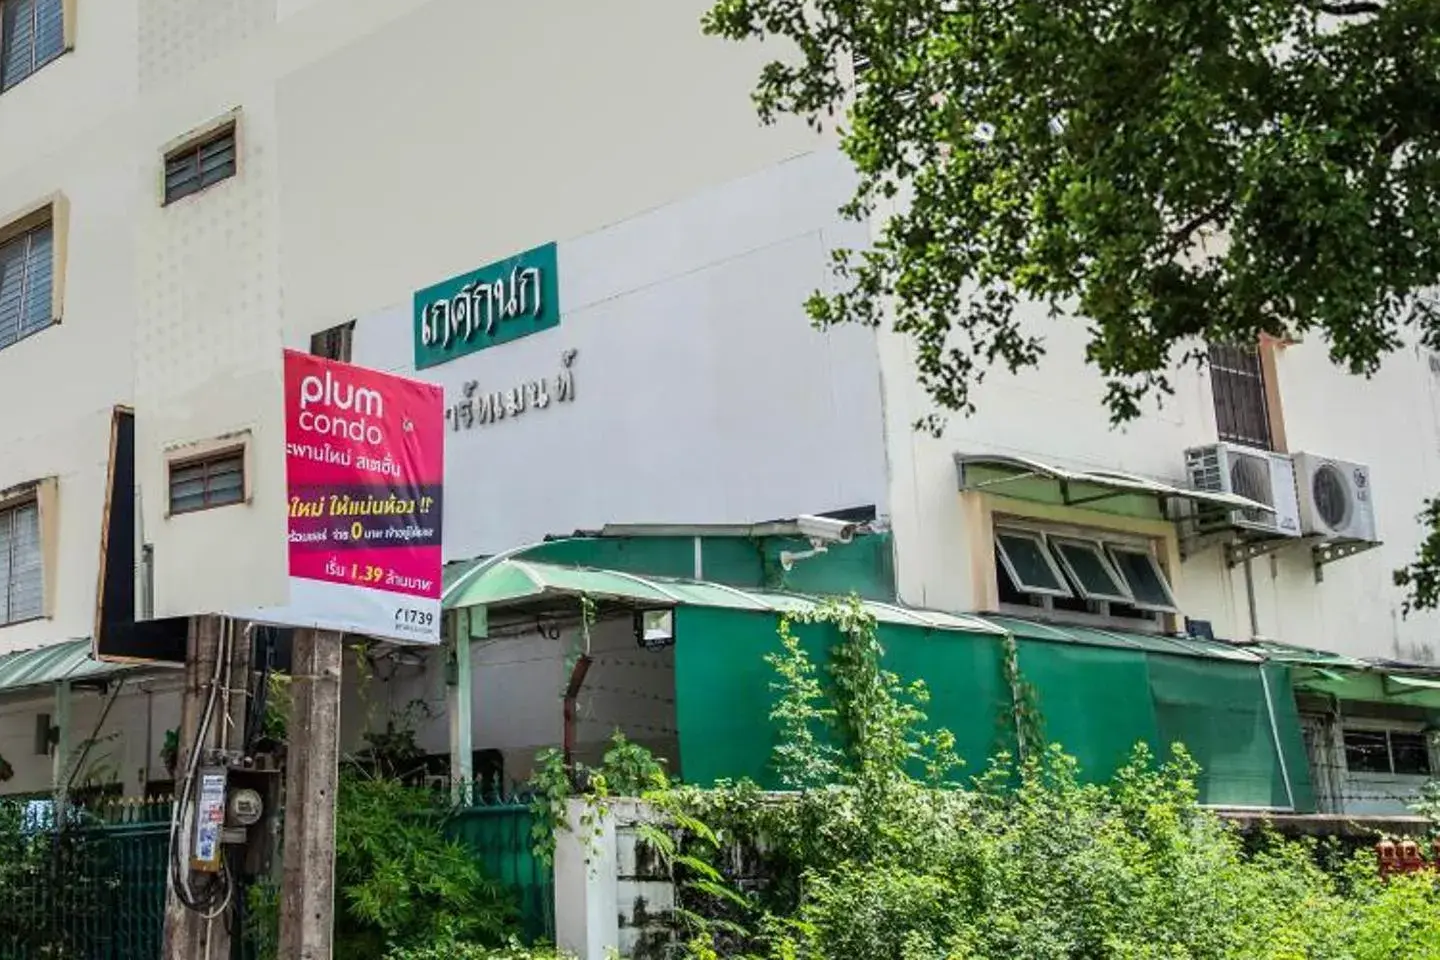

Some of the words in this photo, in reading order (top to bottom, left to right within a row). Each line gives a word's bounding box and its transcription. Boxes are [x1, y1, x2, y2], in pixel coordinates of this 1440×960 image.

[300, 370, 383, 418] plum
[298, 409, 383, 445] condo
[350, 521, 363, 540] 0
[326, 557, 345, 577] เริ่ม
[351, 563, 384, 582] 1.39
[404, 609, 433, 626] 1739
